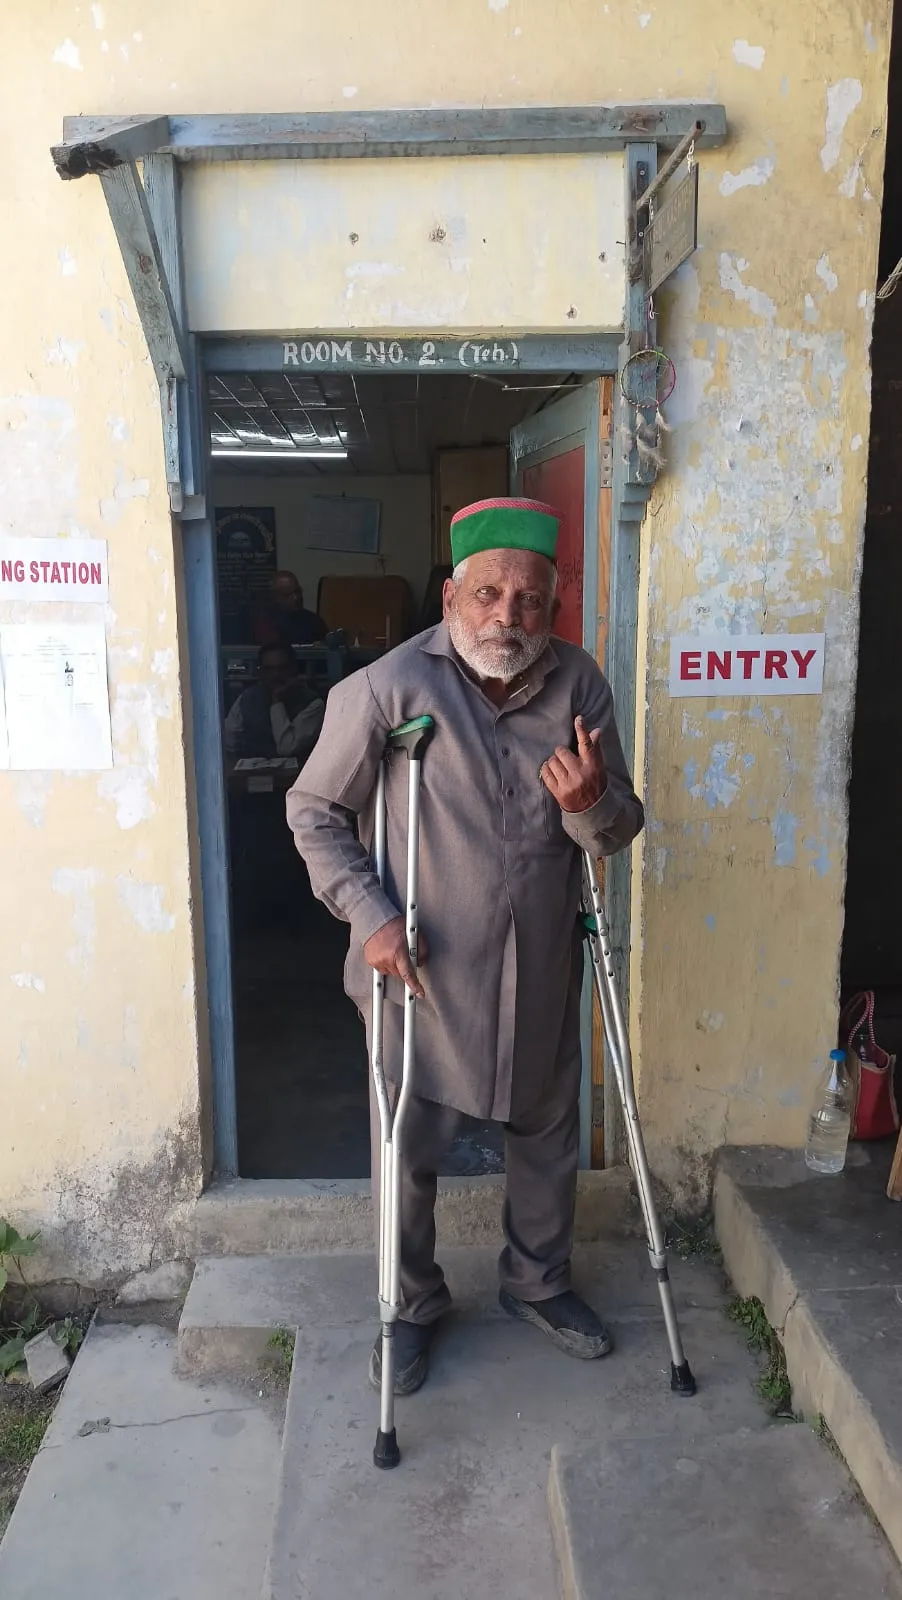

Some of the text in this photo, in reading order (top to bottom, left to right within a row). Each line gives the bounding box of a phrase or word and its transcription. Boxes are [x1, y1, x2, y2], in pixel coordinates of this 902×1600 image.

[282, 341, 353, 365] ROOM
[364, 342, 409, 365] NO.
[418, 341, 445, 366] 2.
[1, 560, 102, 584] NG STATION
[680, 650, 817, 680] ENTRY
